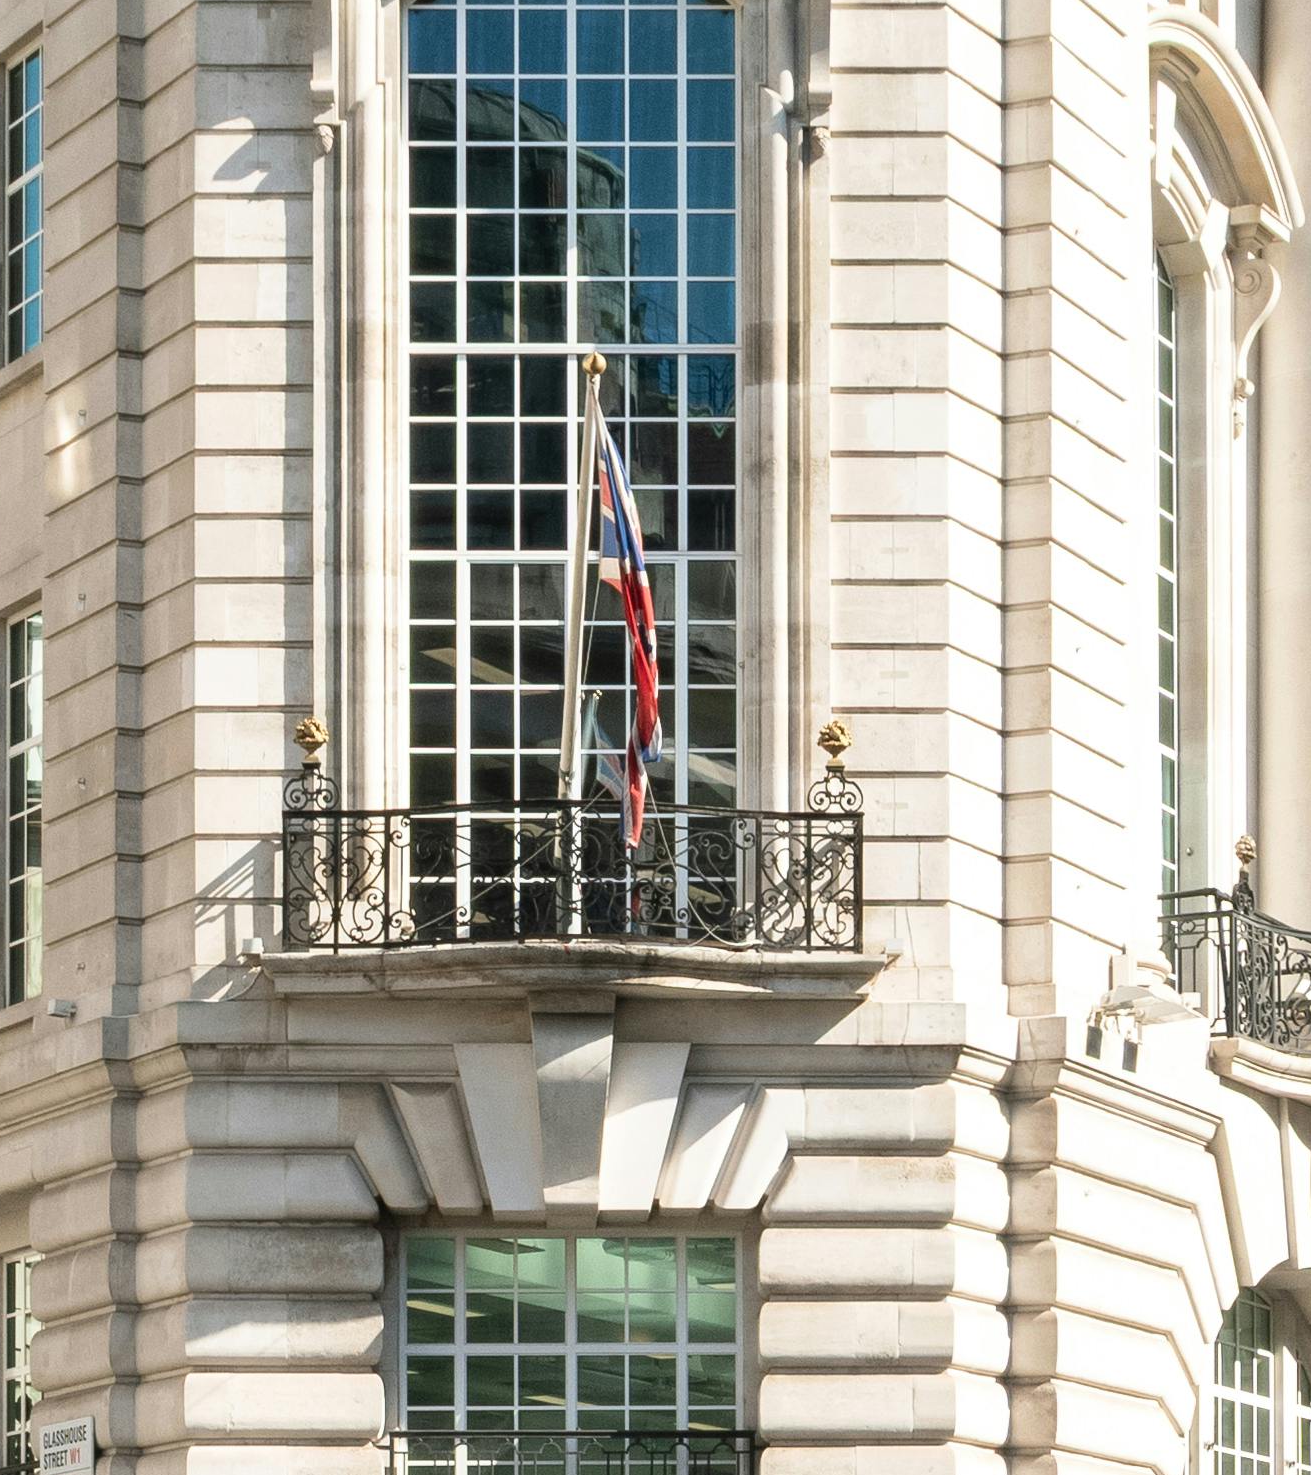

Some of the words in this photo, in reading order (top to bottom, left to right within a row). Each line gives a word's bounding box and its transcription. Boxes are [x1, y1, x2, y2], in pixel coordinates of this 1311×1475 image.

[43, 1424, 87, 1449] GLASSHOUSE
[43, 1450, 68, 1470] STREET
[69, 1447, 81, 1465] W1
